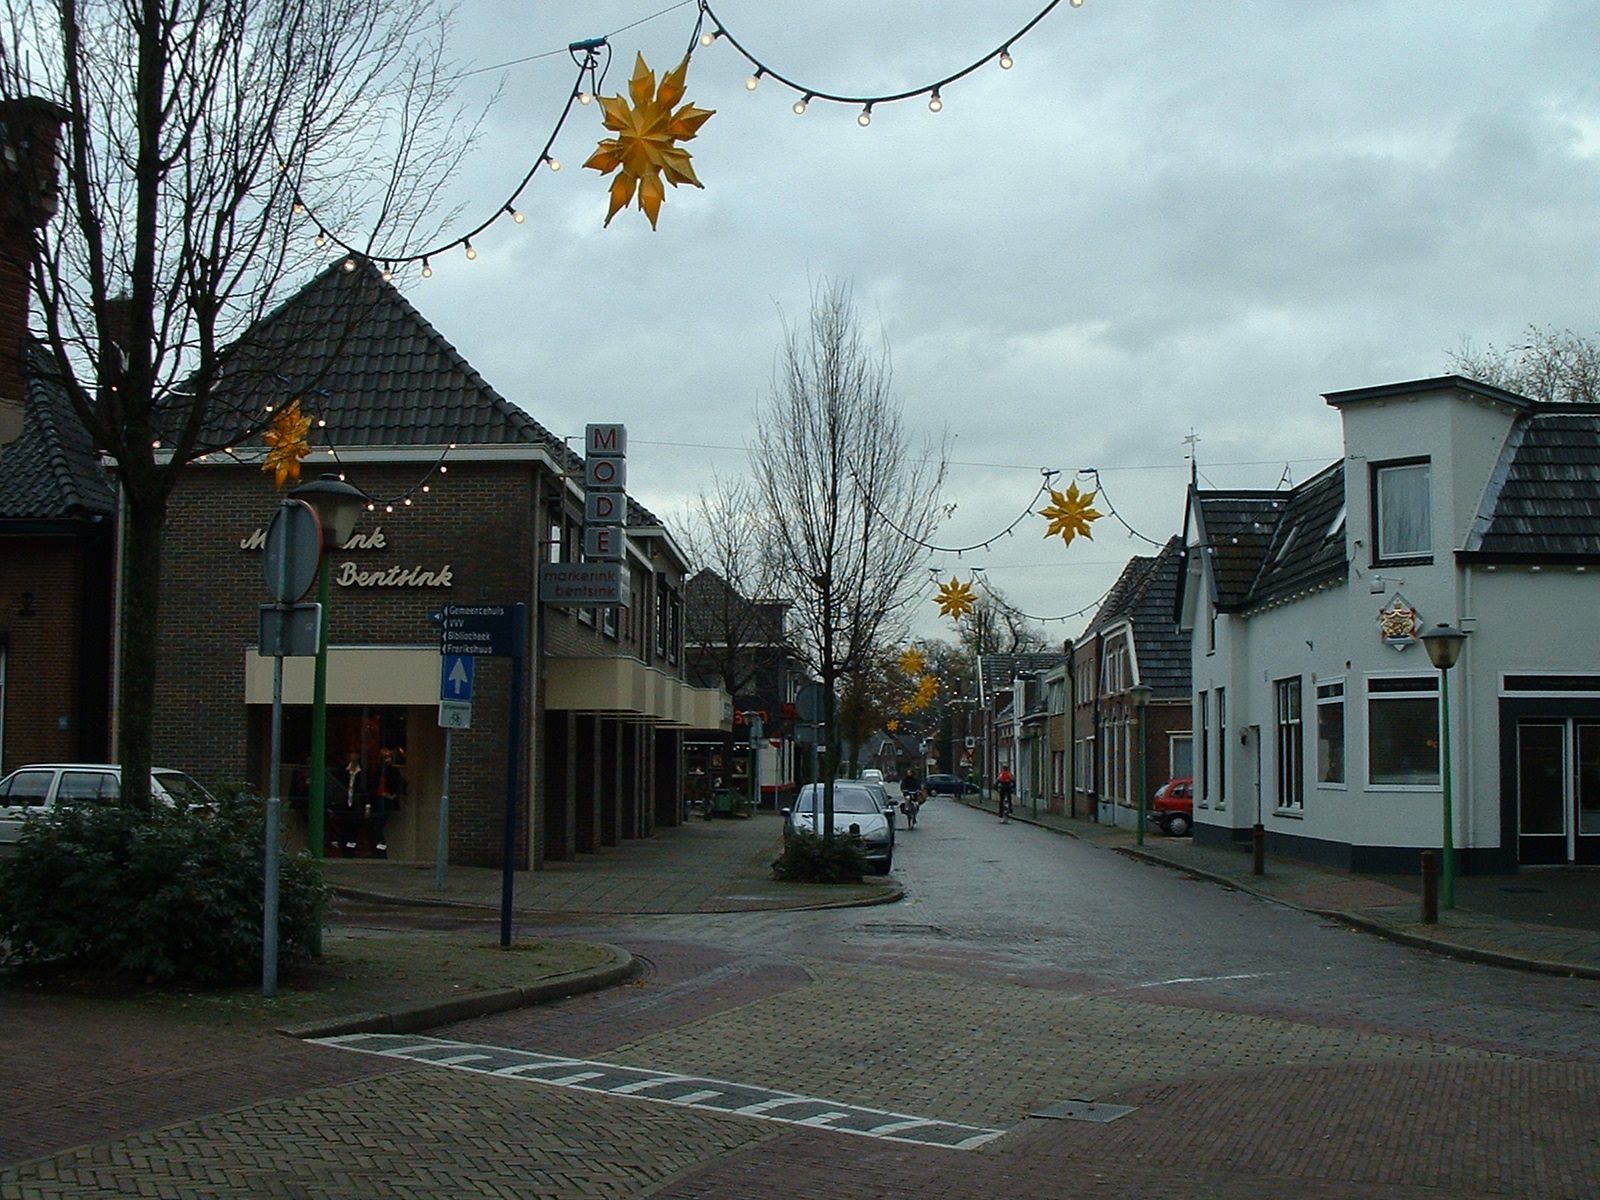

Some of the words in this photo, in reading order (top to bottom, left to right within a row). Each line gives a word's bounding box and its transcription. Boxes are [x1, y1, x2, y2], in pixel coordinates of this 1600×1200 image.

[593, 427, 617, 553] MODE
[336, 561, 453, 587] Bentsink
[544, 570, 617, 583] markerink
[555, 584, 617, 598] bentsink
[448, 618, 465, 628] VVV
